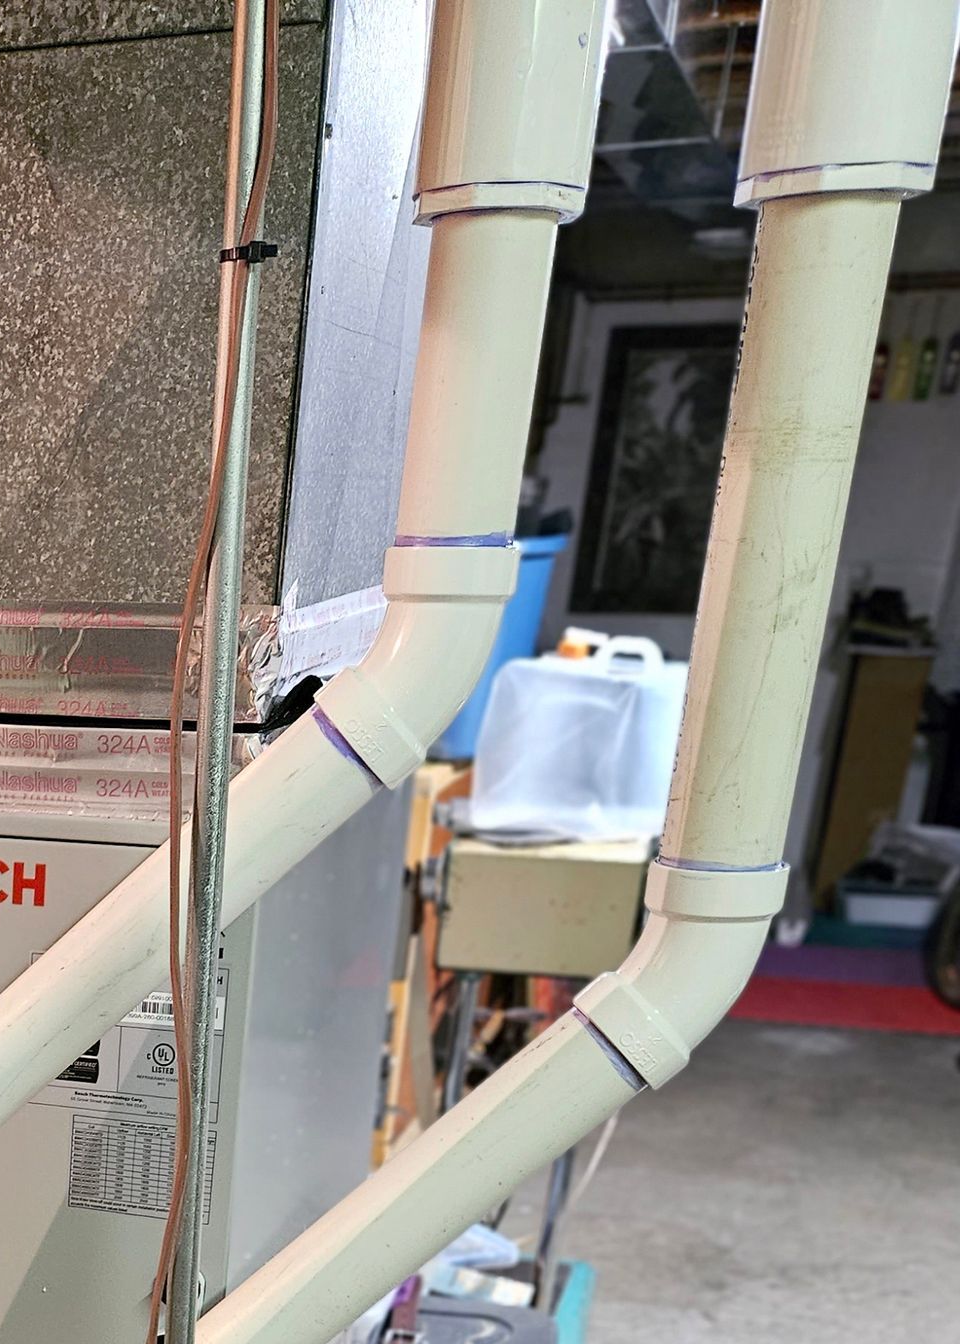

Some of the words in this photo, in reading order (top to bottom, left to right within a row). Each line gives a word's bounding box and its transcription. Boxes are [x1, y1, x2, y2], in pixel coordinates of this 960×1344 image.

[97, 735, 151, 754] 324A
[96, 779, 149, 798] 324A
[151, 1065, 174, 1075] LISTED
